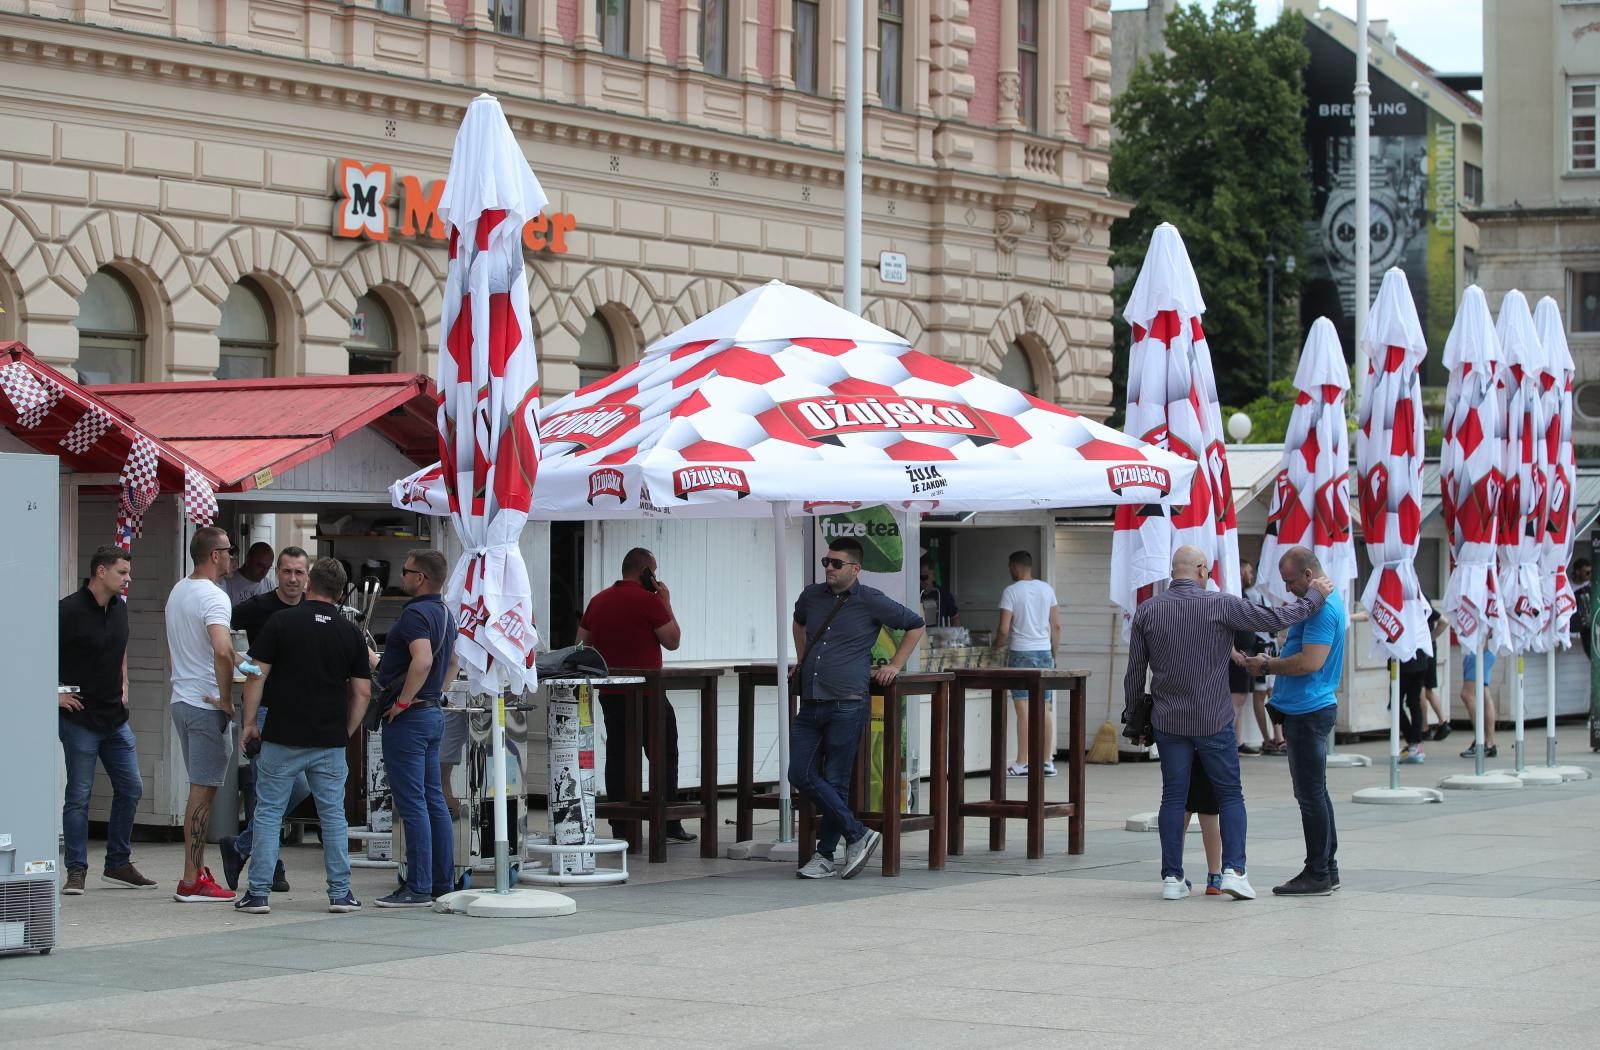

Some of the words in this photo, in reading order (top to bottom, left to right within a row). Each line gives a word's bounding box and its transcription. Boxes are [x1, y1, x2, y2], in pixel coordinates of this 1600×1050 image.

[1319, 103, 1407, 117] BREILING
[1436, 124, 1453, 230] CHRONOMAT
[352, 183, 377, 217] M
[400, 176, 576, 253] Mer
[798, 398, 976, 430] Ožujsko
[591, 471, 622, 495] Ožujsko
[679, 466, 743, 491] Ožujsko
[905, 465, 942, 482] ŽUJA
[1112, 465, 1167, 486] Ožujsko
[912, 485, 920, 493] JE
[921, 479, 947, 491] ZAKON!
[820, 517, 899, 537] fuzetea
